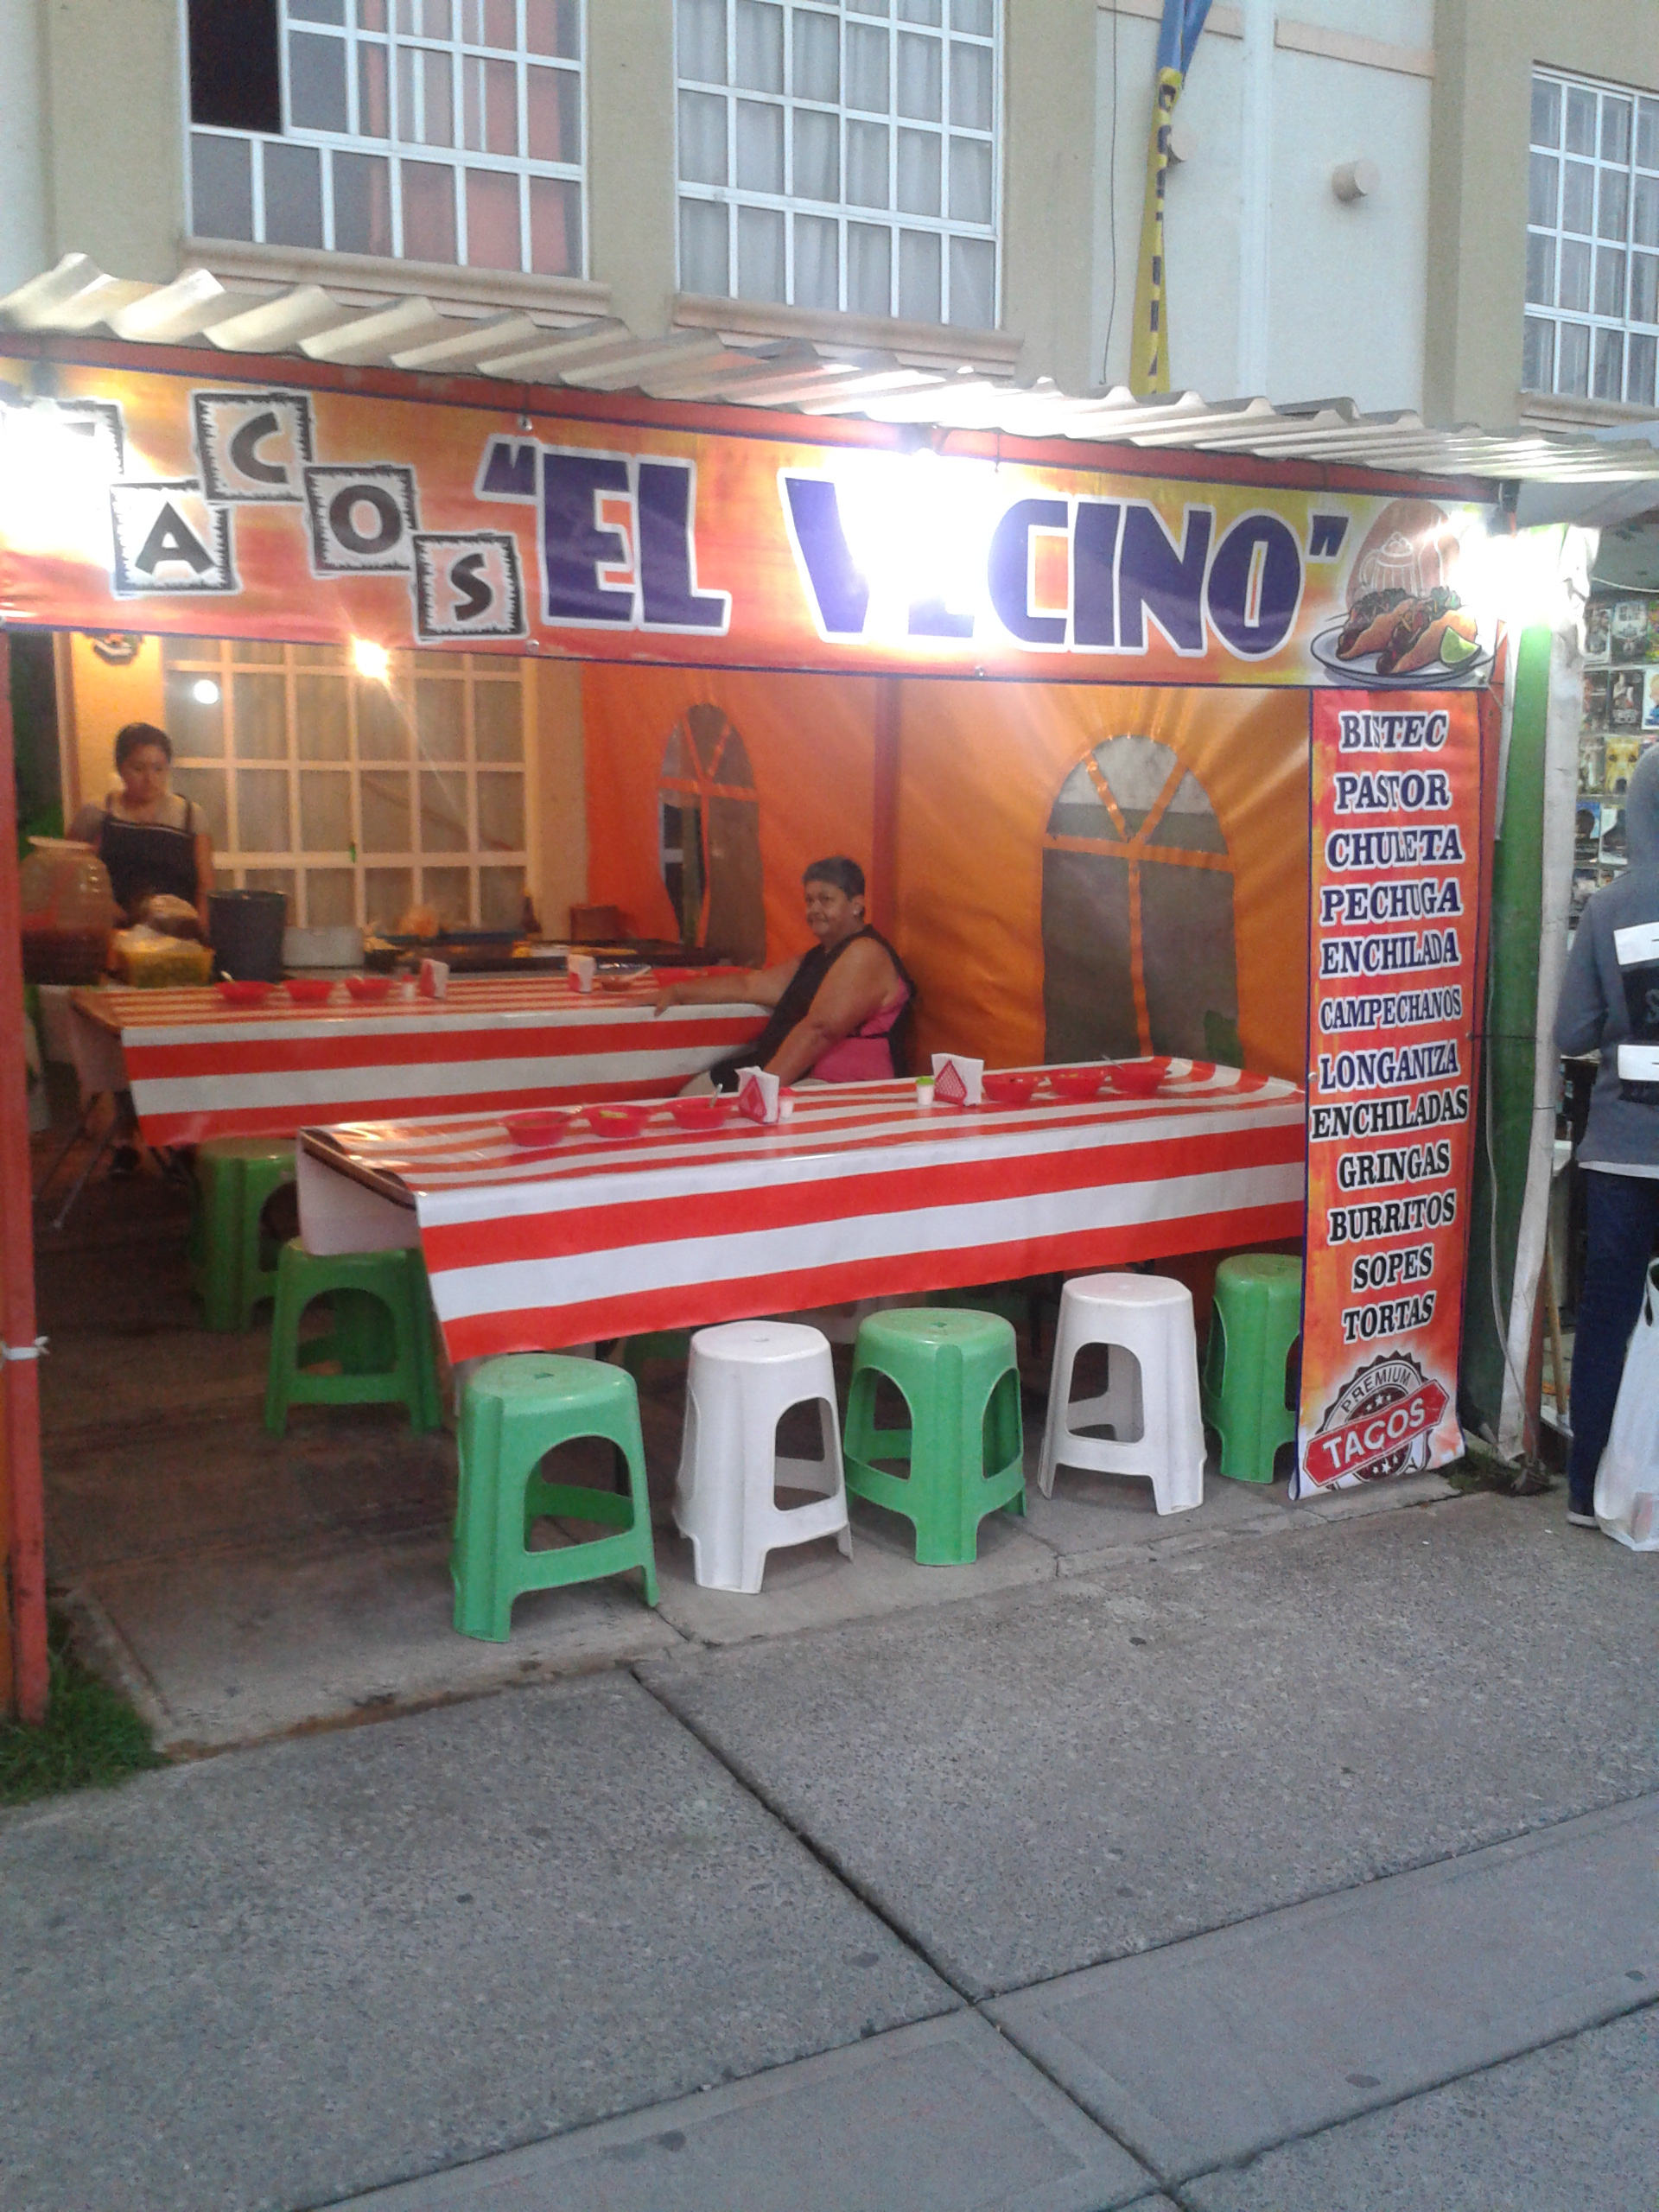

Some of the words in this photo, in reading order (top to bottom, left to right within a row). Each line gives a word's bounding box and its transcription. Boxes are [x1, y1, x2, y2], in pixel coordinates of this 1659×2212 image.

[35, 410, 495, 624] ACOS
[1340, 712, 1448, 749] BISTEC
[1336, 772, 1452, 810] PASTOR
[1327, 827, 1463, 868] CHULETA
[1321, 880, 1462, 923] PECHUGA
[1321, 931, 1460, 976] ENCHILADA
[1319, 987, 1463, 1031] CAMPECHANOS
[1319, 1042, 1459, 1090] LONGANIZA
[1312, 1088, 1469, 1140] ENCHILADAS
[1338, 1142, 1451, 1189] GRINGAS
[1329, 1192, 1457, 1243] BURRITOS
[1352, 1245, 1434, 1290] SOPES
[1343, 1294, 1435, 1341] TORTAS
[1340, 1366, 1411, 1414] PREMIUM
[1322, 1397, 1426, 1469] TACOS
